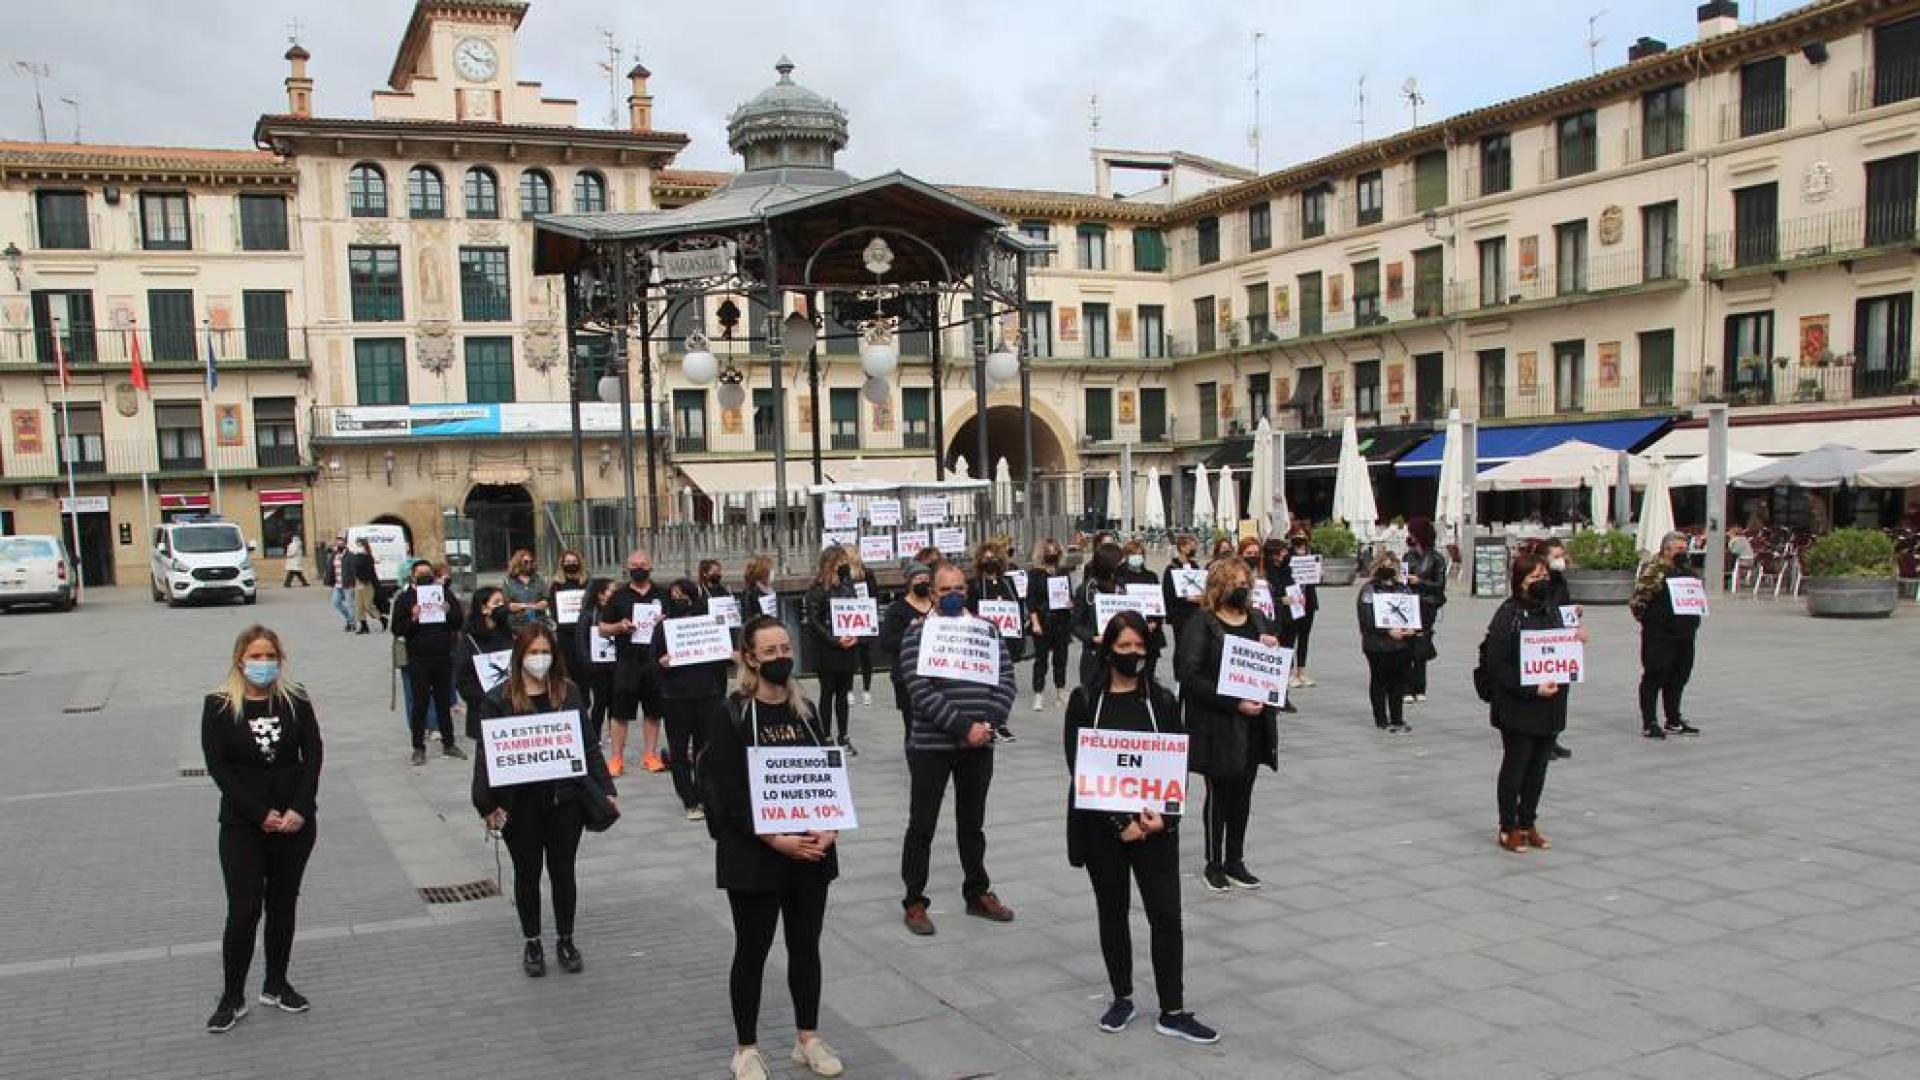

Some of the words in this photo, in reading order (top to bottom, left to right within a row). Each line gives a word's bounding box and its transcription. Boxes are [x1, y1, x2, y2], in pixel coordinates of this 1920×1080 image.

[1541, 645, 1556, 655] EN
[1523, 659, 1580, 676] LUCHA
[492, 729, 509, 740] LA
[496, 748, 575, 769] ESENCIAL
[766, 757, 828, 769] QUEREMOS
[1116, 753, 1143, 768] EN
[765, 773, 832, 784] RECUPERAR
[763, 790, 778, 800] LO
[1078, 775, 1184, 802] LUCHA
[761, 806, 786, 820] IVA
[791, 805, 809, 819] AL
[814, 804, 845, 818] 10%
